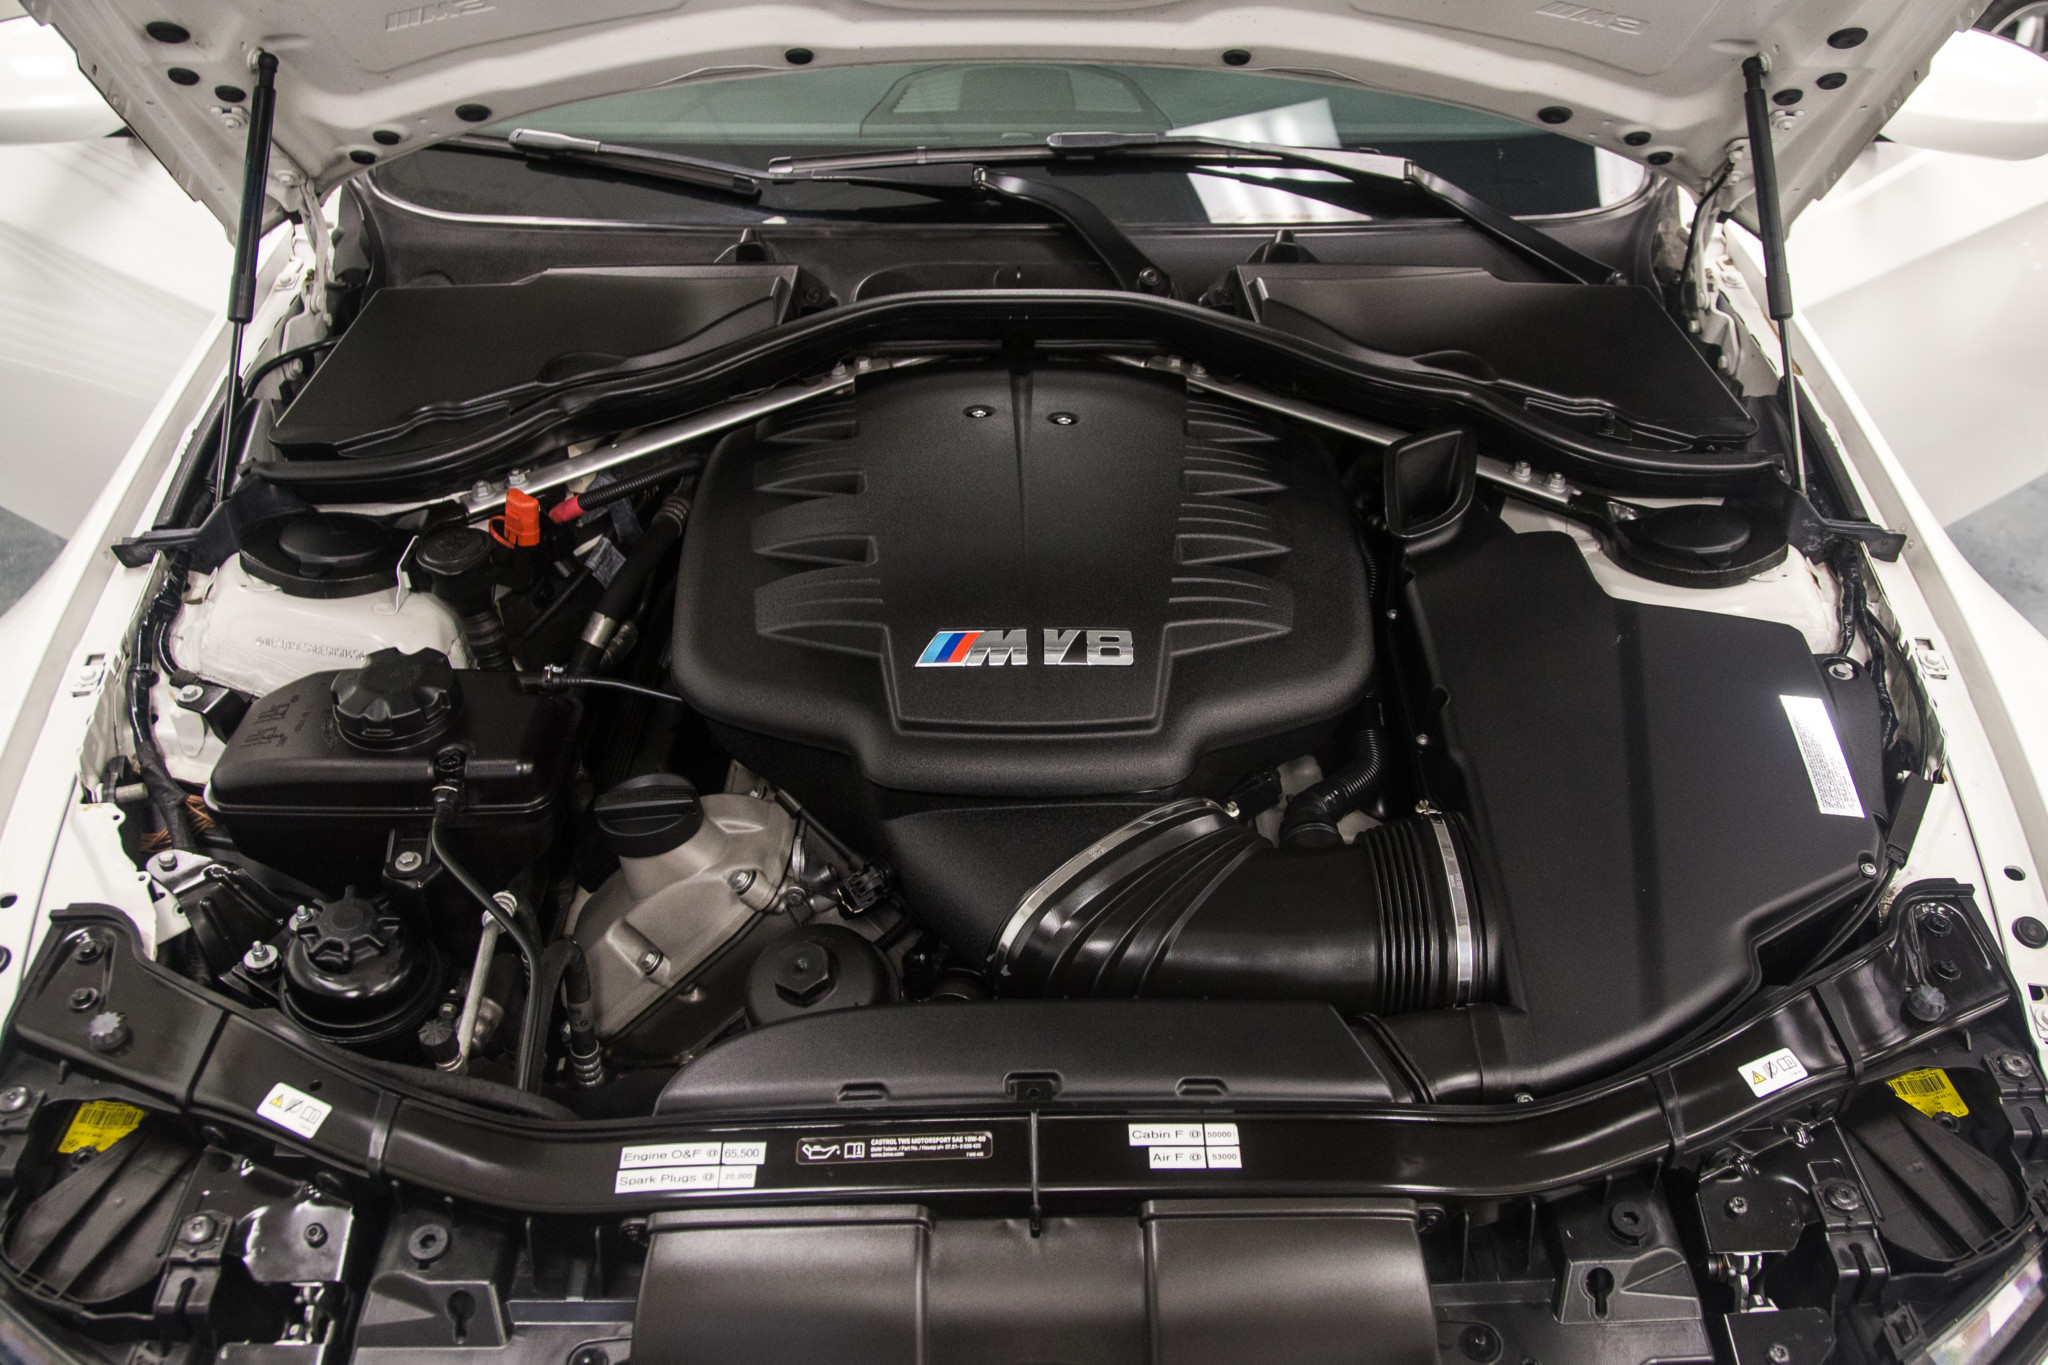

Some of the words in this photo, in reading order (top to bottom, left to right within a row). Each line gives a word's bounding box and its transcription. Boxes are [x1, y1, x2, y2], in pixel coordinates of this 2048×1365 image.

[1044, 628, 1134, 667] V8
[1132, 1130, 1170, 1139] Cabin
[1175, 1130, 1183, 1138] F
[1189, 1130, 1201, 1139] @
[871, 1138, 897, 1146] CASTROL
[911, 1136, 951, 1145] MOTORSPORT
[624, 1151, 667, 1162] Engine
[671, 1149, 701, 1159] O&F
[706, 1149, 719, 1158] @
[1153, 1153, 1171, 1161] Air
[1175, 1153, 1183, 1161] F
[1189, 1153, 1201, 1161] @
[619, 1175, 656, 1186] Spark
[660, 1173, 696, 1184] Plugs
[702, 1173, 715, 1181] @
